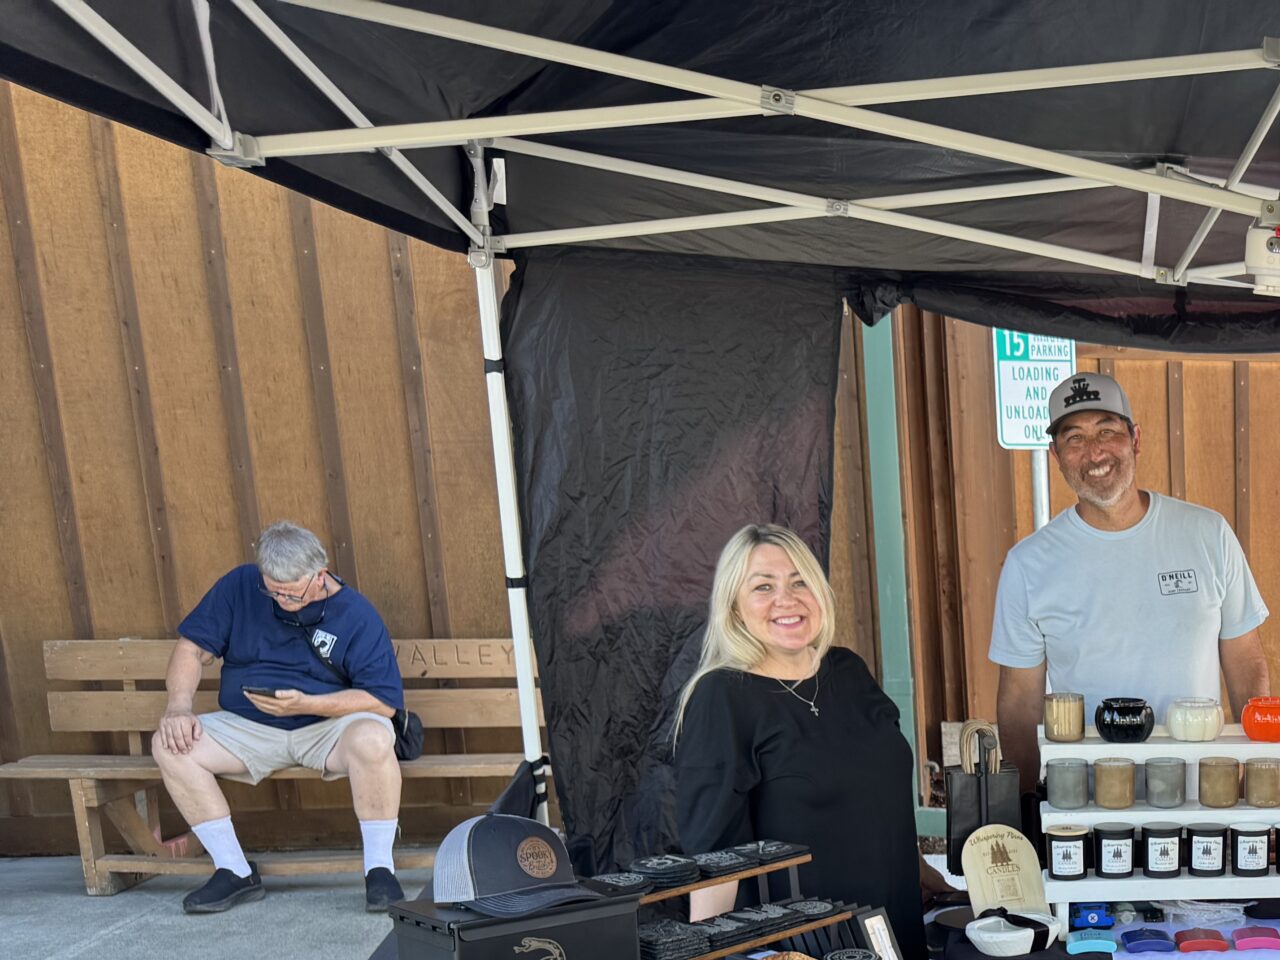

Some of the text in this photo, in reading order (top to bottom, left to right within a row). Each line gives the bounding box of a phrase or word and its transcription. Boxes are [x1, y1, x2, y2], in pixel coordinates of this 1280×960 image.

[1003, 330, 1025, 357] 15
[1031, 344, 1069, 357] PARKING
[1011, 365, 1059, 381] LOADING
[1025, 386, 1047, 401] AND
[1024, 425, 1051, 440] ONL
